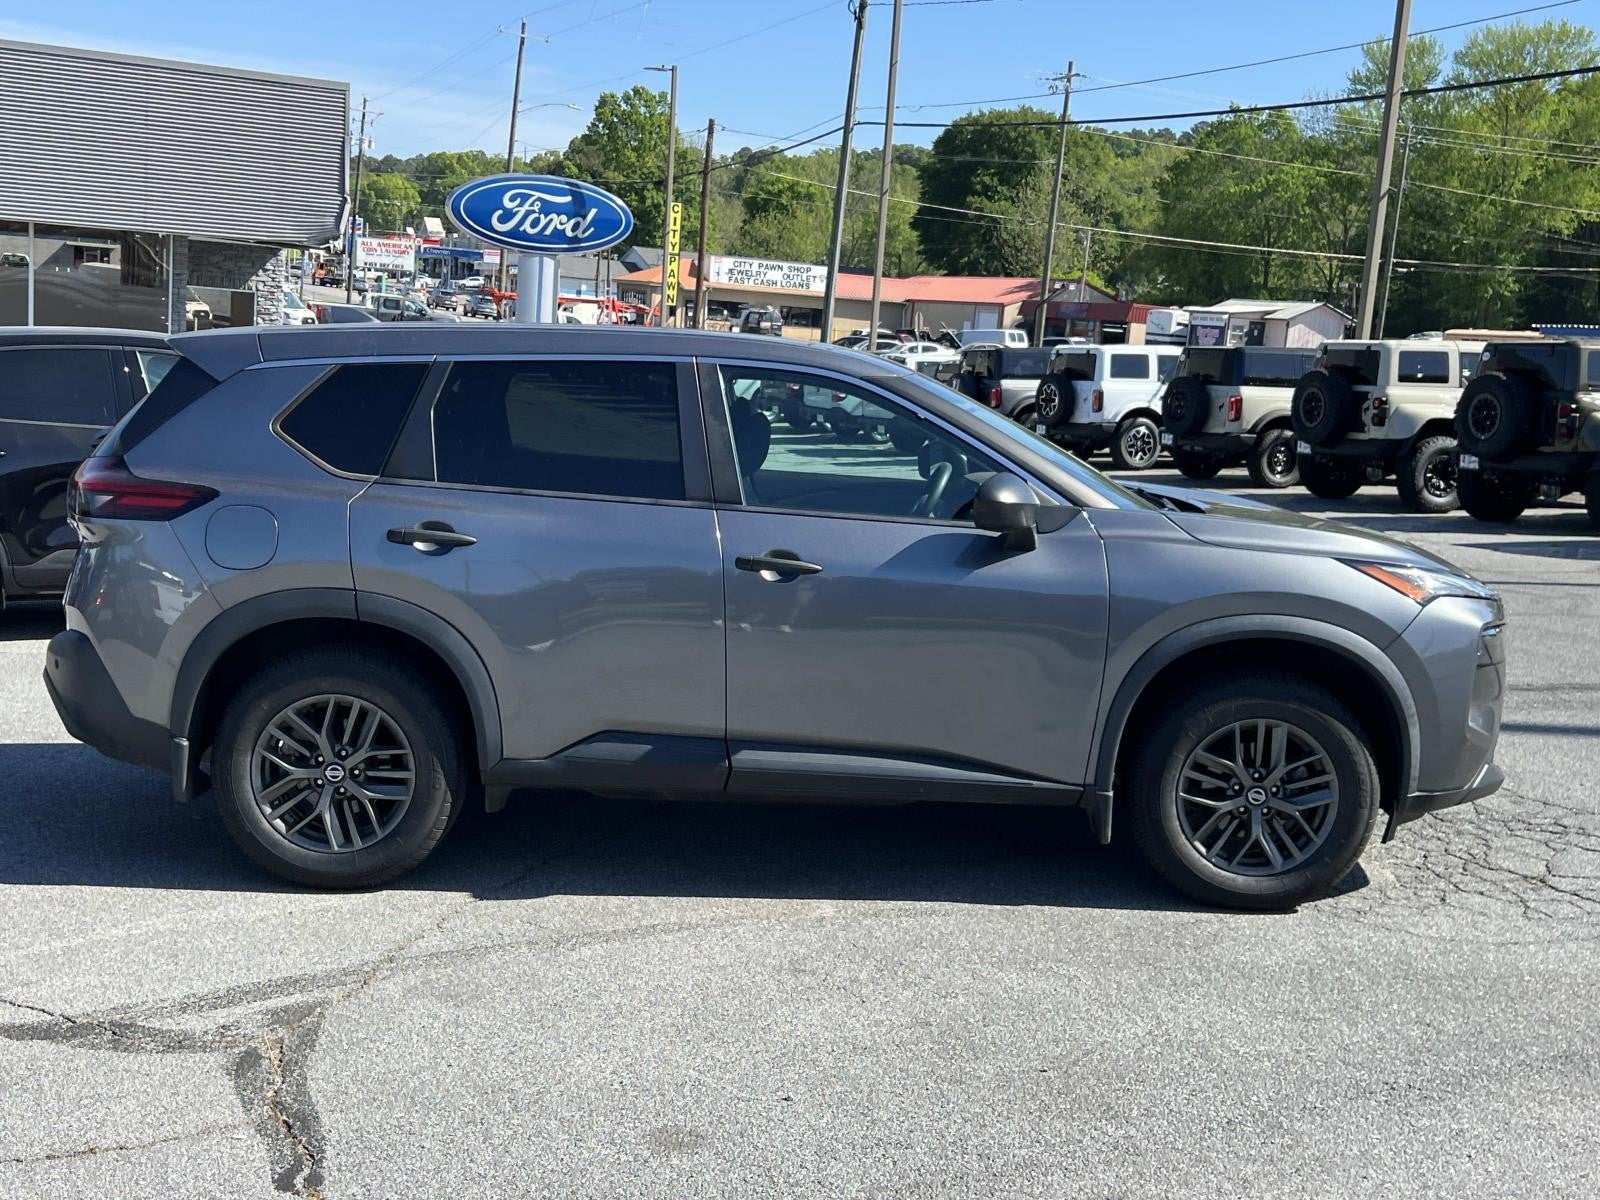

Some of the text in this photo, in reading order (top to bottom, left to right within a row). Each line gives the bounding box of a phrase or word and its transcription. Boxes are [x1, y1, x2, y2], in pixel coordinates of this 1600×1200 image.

[491, 188, 598, 239] Ford
[376, 240, 413, 250] AMERICAN
[380, 247, 410, 255] LAUNDRY
[666, 203, 680, 303] CITY PAWN
[733, 260, 812, 274] CITY PAWN SHOP
[725, 268, 816, 283] JEWELRY OUTLET
[728, 276, 811, 290] FAST CASH LOANS
